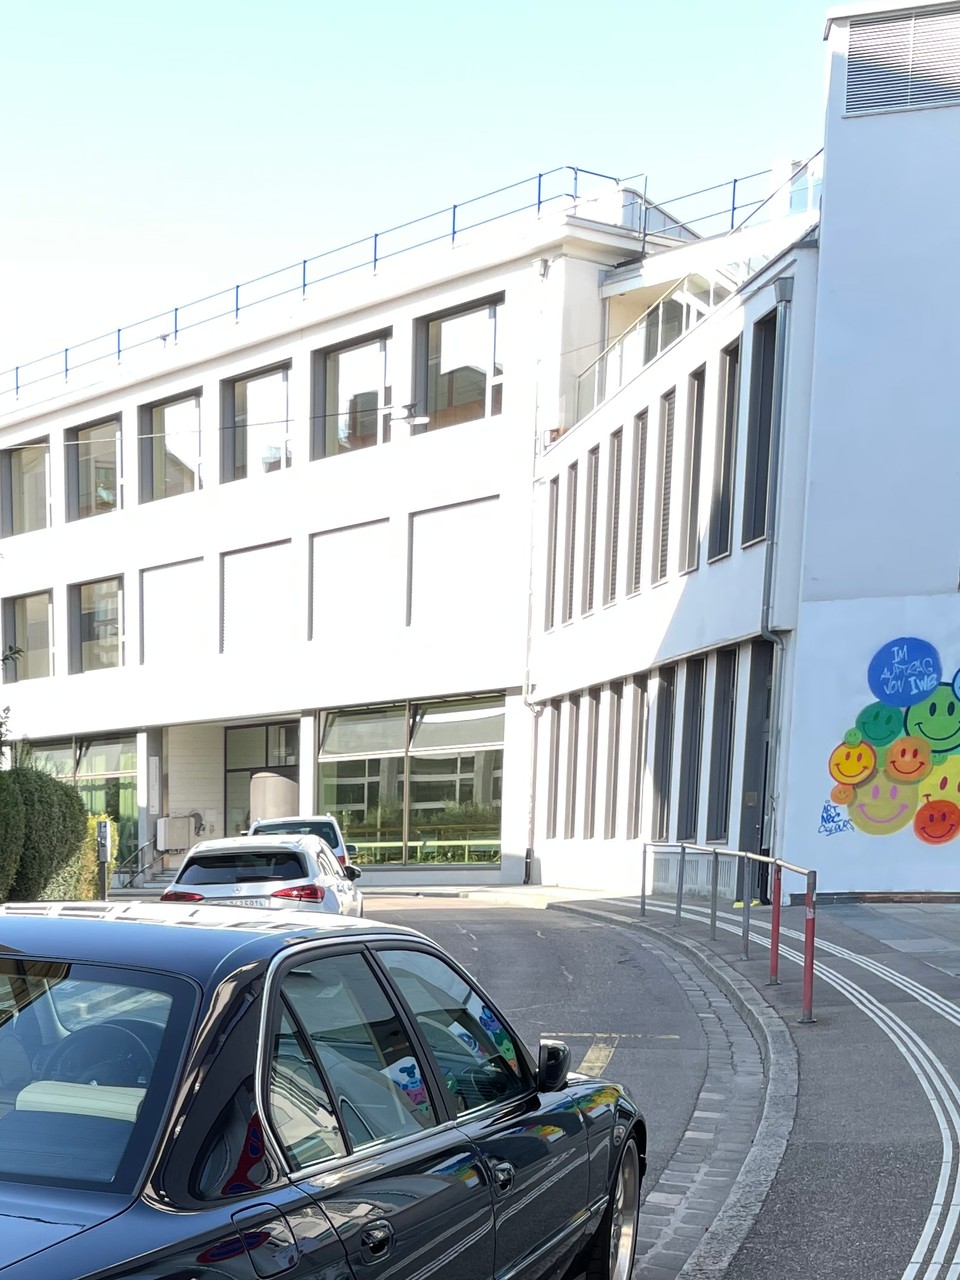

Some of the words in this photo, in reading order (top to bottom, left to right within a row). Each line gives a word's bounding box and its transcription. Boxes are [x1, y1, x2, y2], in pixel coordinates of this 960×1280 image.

[891, 644, 908, 664] IM
[880, 657, 933, 681] AUFTRAG
[908, 673, 938, 695] IWB
